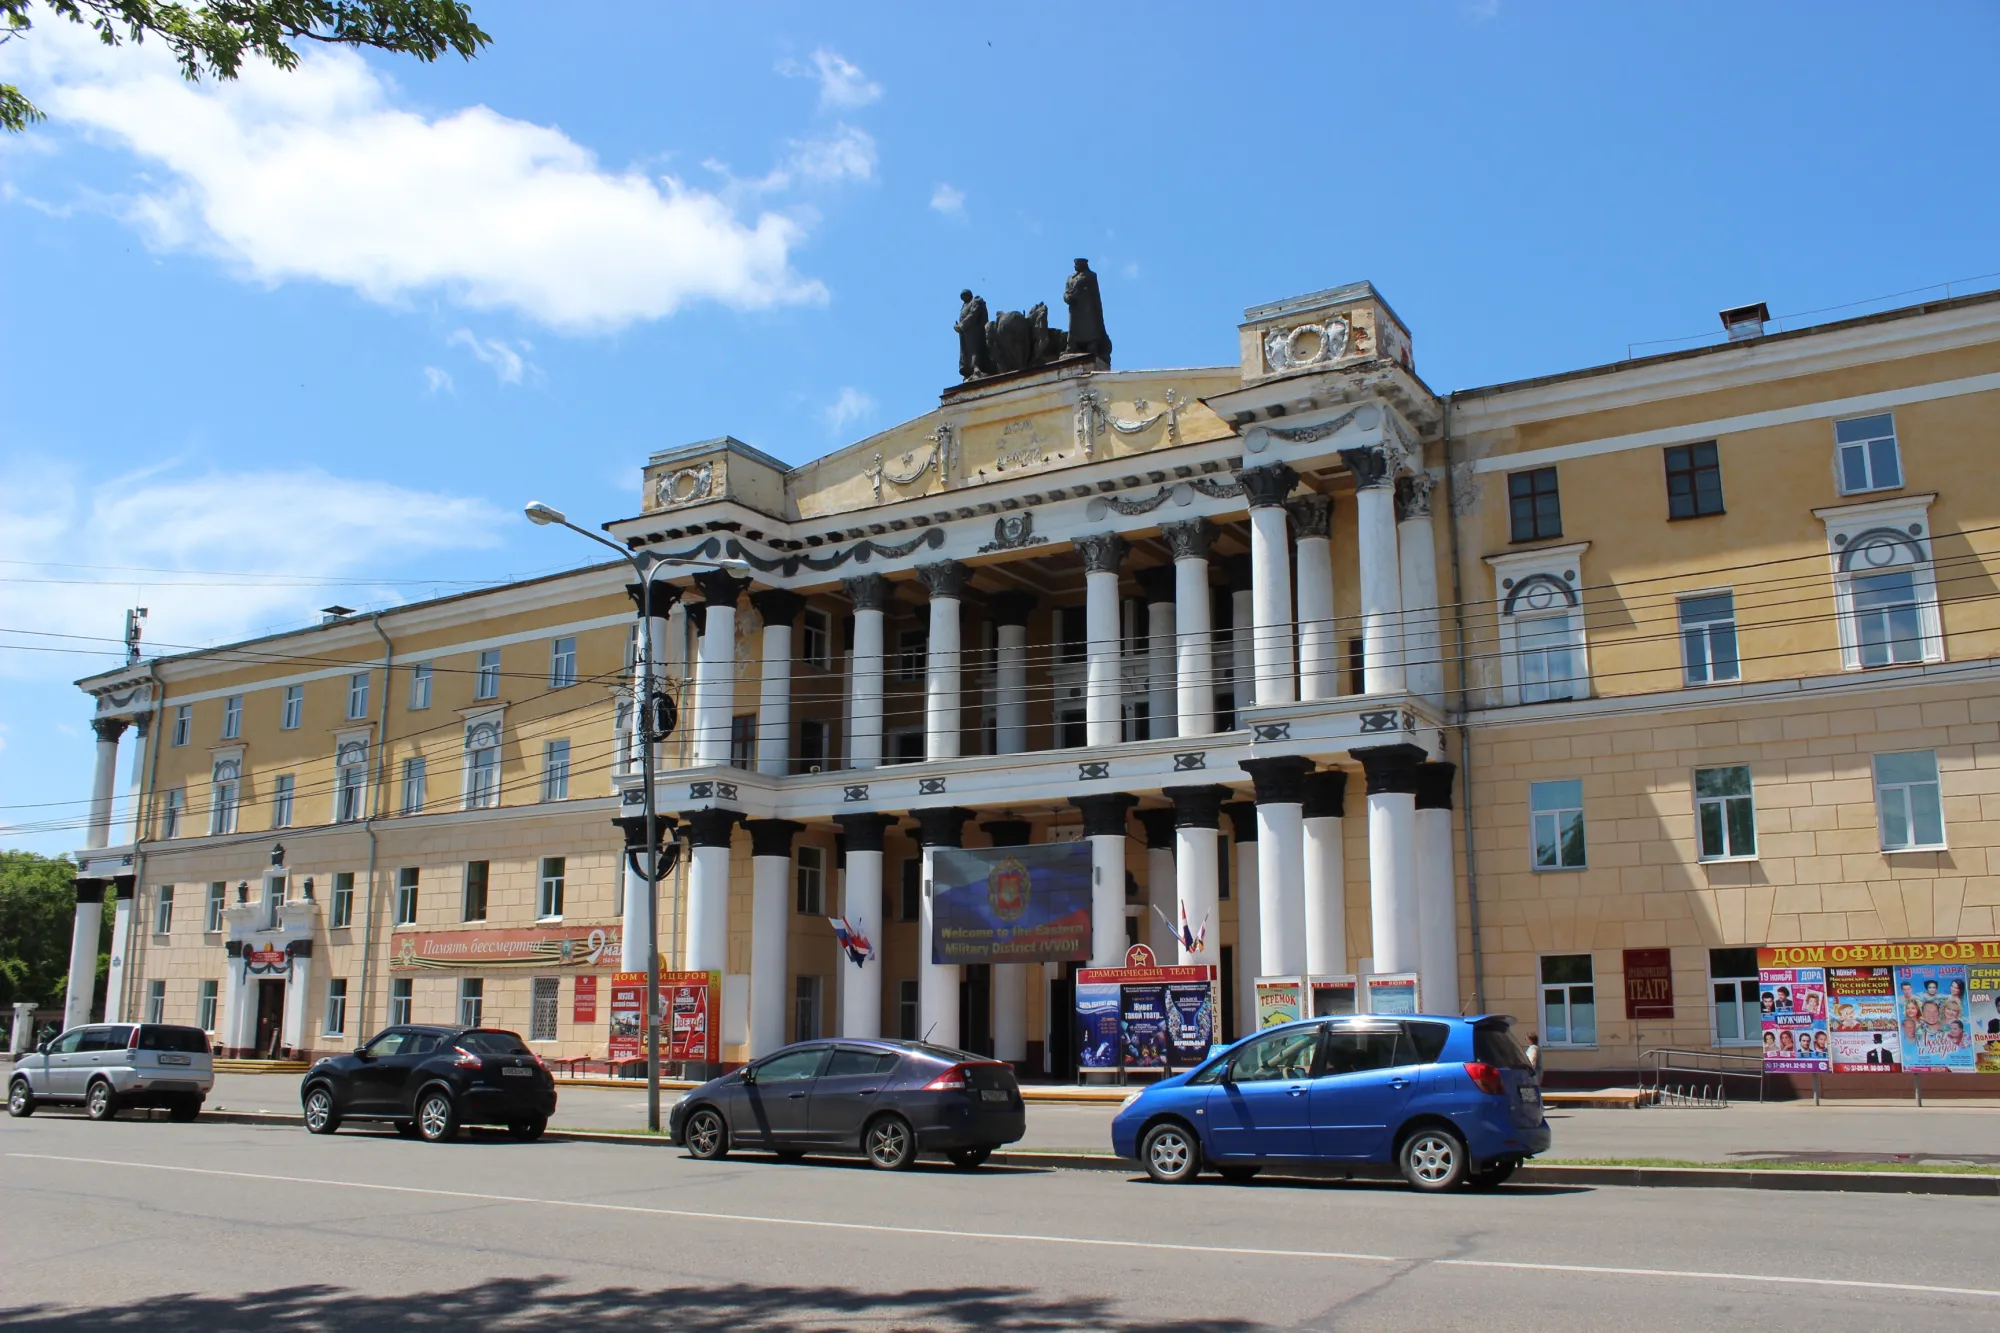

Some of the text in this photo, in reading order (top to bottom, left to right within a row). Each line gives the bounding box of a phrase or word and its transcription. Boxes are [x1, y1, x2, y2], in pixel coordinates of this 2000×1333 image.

[941, 923, 1084, 938] Welcome to the Eastern
[423, 936, 546, 956] Память бессмертна!
[587, 929, 606, 964] 9
[945, 942, 988, 955] Military
[992, 941, 1036, 954] District
[1772, 947, 1826, 967] ДОМ
[1831, 943, 1976, 965] ОФИЦЕРОВ
[1088, 968, 1163, 979] ДРАМАТИЧЕСКИЙ
[1169, 967, 1196, 976] ТЕАТР
[1801, 971, 1822, 980] ДОРА
[1830, 968, 1857, 976] 4 НОЯБРЯ
[1873, 967, 1888, 977] ДОРА
[1898, 966, 1912, 979] 19
[1939, 966, 1965, 975] ДОРА
[613, 972, 707, 982] ДОМ ОИЦЕРОВ
[1760, 972, 1792, 982] 19 НОЯБРЯ
[1628, 978, 1669, 1000] ТЕАТР
[1970, 978, 2000, 990] ВЕТ
[1260, 994, 1297, 1006] ТЕРЕМОК
[1971, 994, 1991, 1003] ДОРА
[1777, 1015, 1812, 1025] МУЖЧИНА
